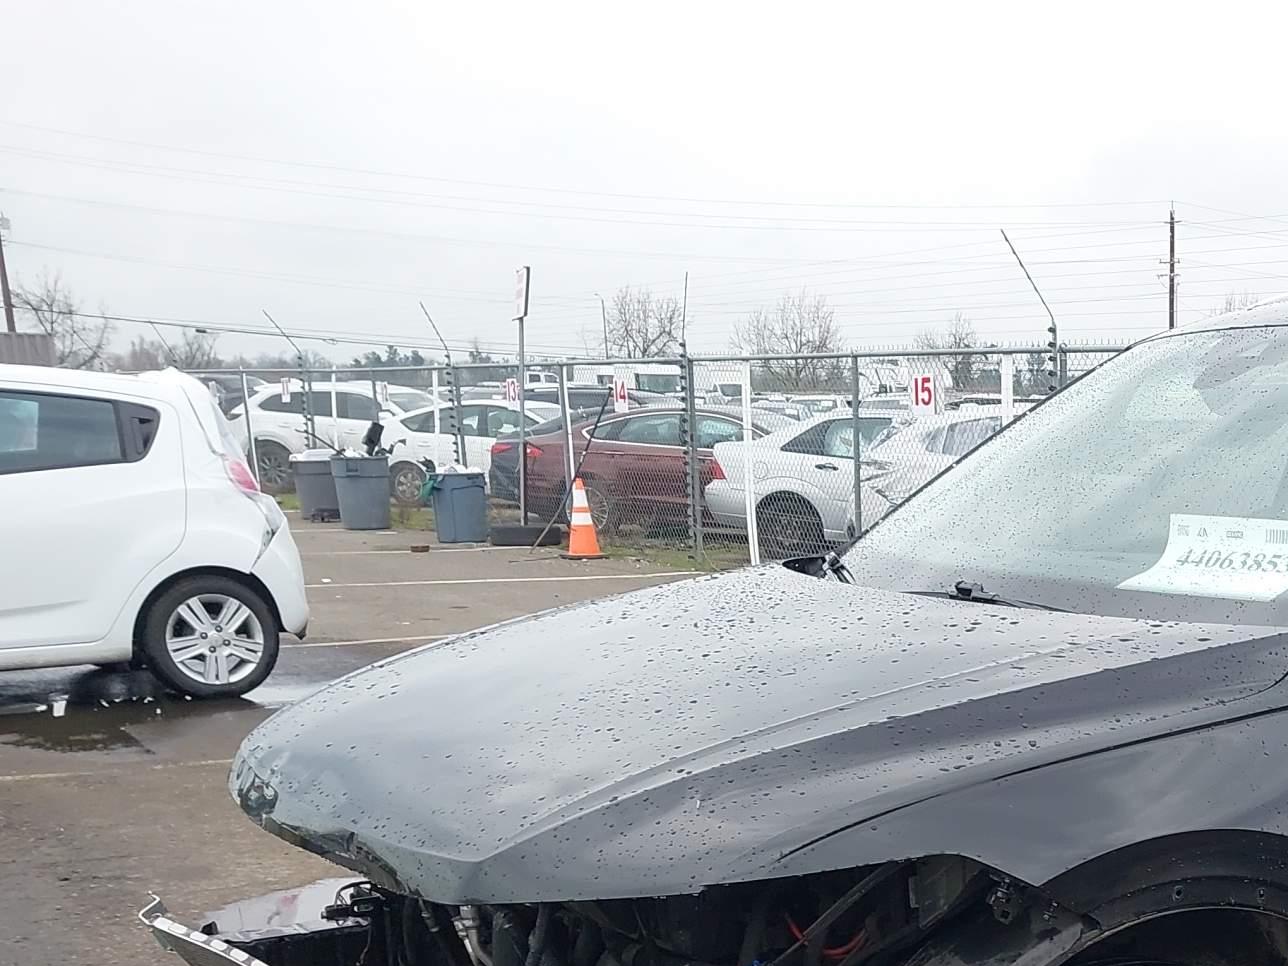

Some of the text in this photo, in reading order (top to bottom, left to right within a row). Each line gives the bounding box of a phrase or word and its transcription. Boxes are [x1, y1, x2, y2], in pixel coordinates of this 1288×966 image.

[507, 380, 517, 401] 13
[615, 381, 626, 403] 14
[914, 377, 932, 406] 15
